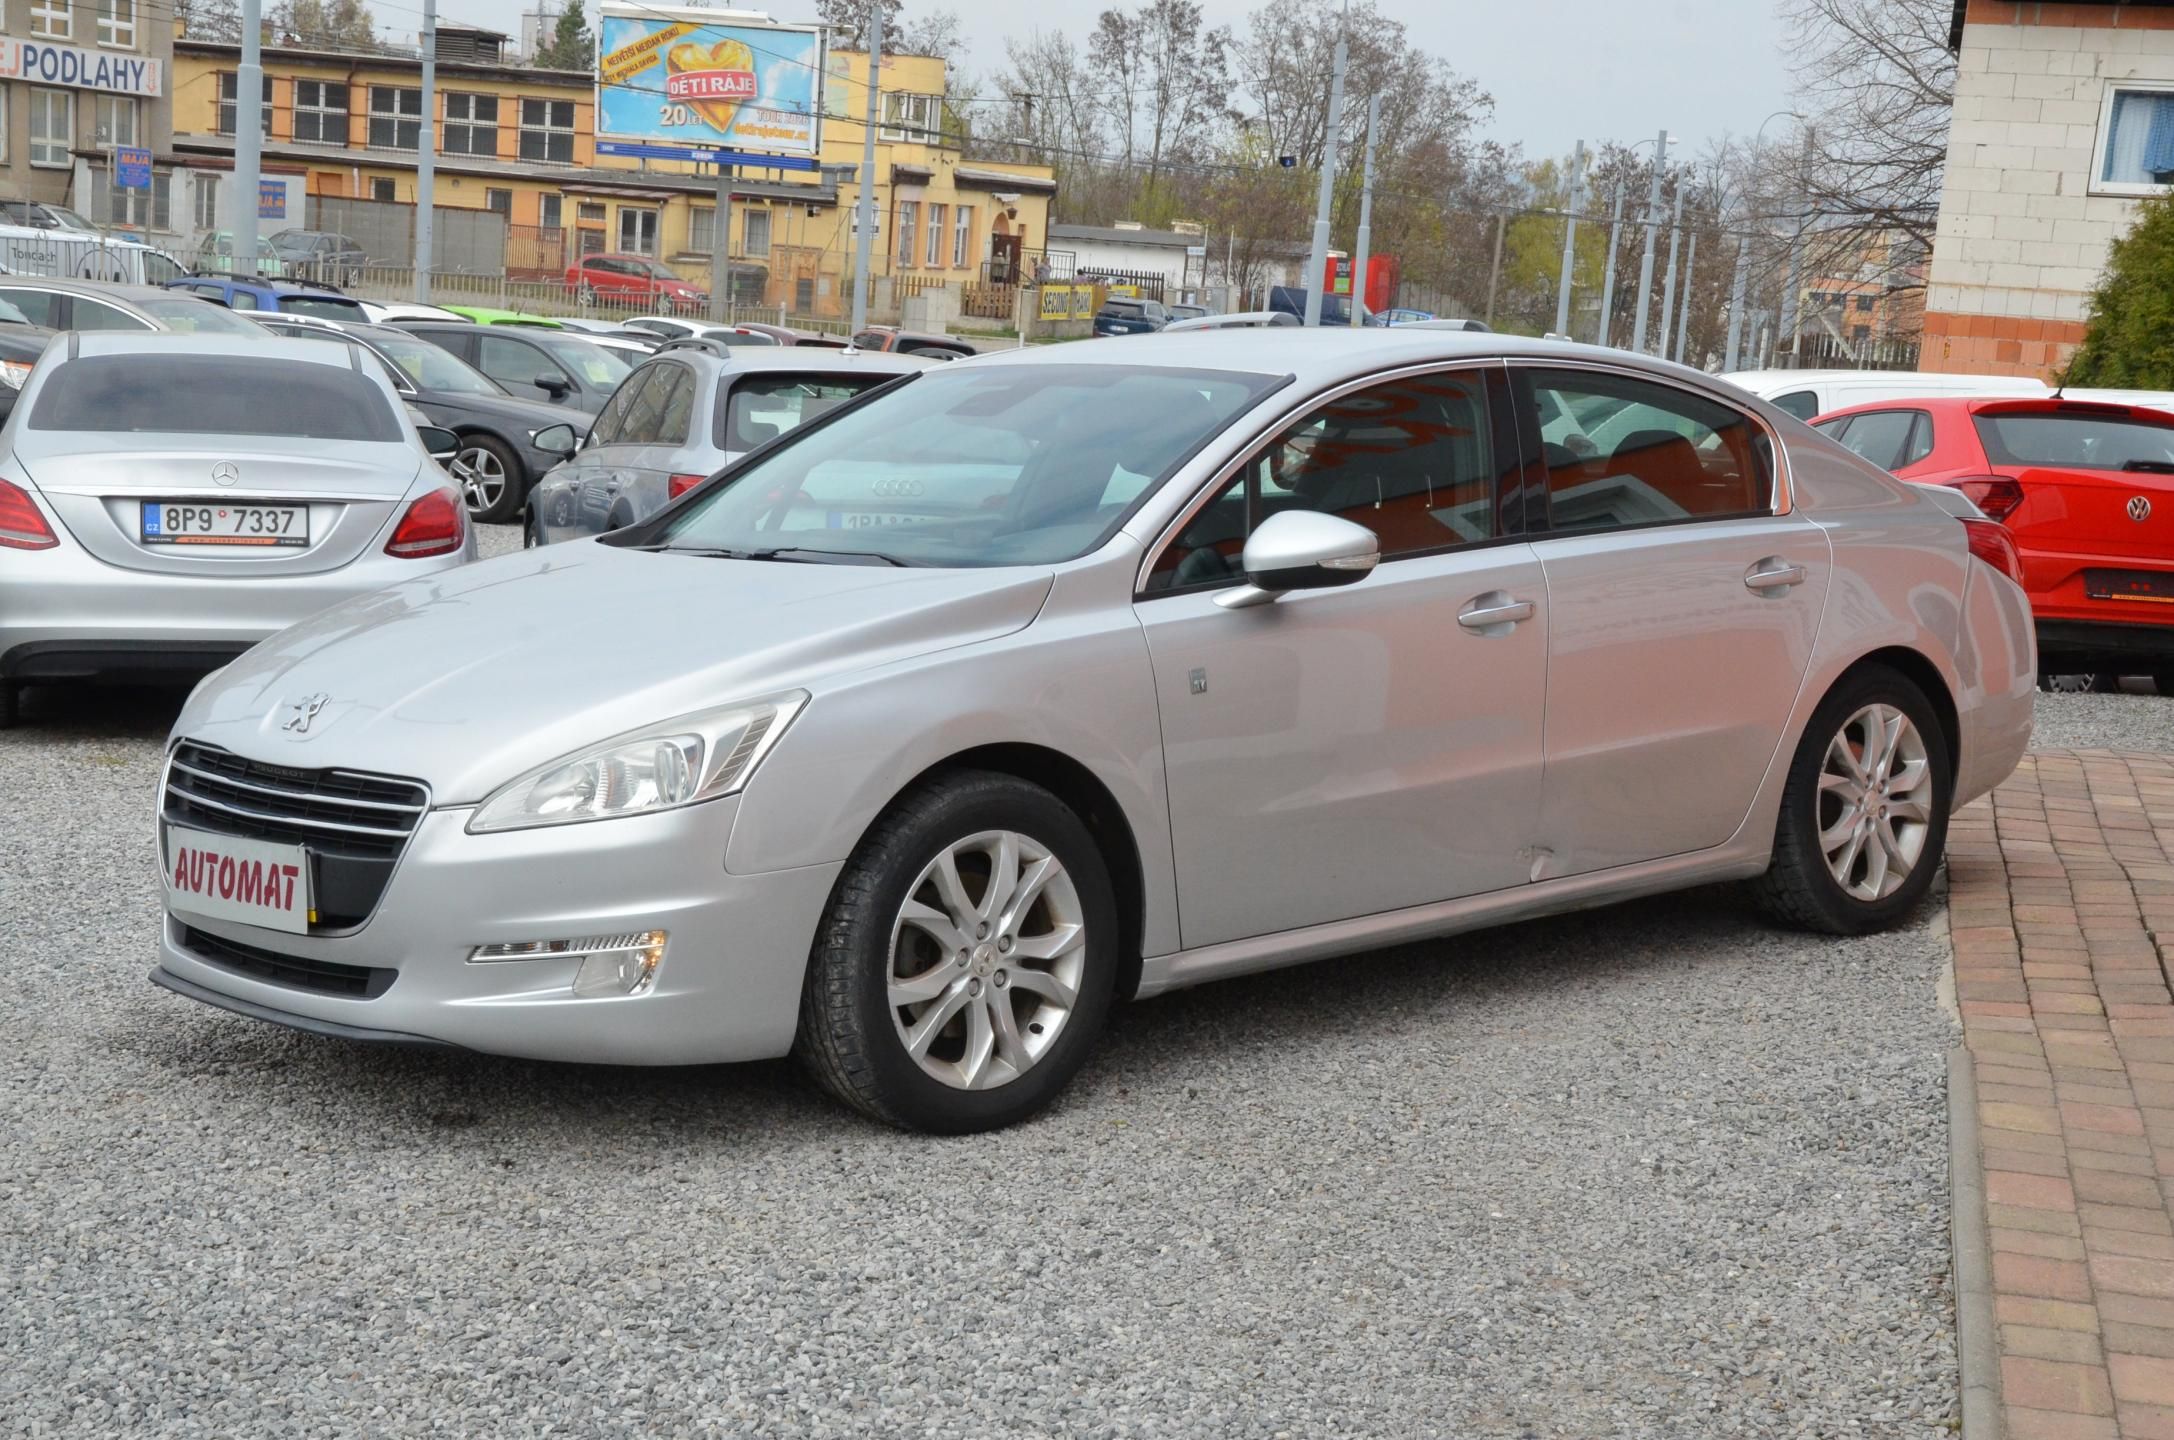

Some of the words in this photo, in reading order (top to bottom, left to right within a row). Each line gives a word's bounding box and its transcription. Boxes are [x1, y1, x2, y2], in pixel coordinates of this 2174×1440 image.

[23, 44, 145, 91] PODLAHY
[711, 73, 753, 92] RÁJE
[660, 105, 687, 126] 20
[146, 523, 159, 532] CZ
[166, 507, 213, 532] 8P9
[233, 509, 295, 534] 7337
[254, 764, 305, 778] PEUGEOT
[175, 847, 299, 911] AUTOMAT
